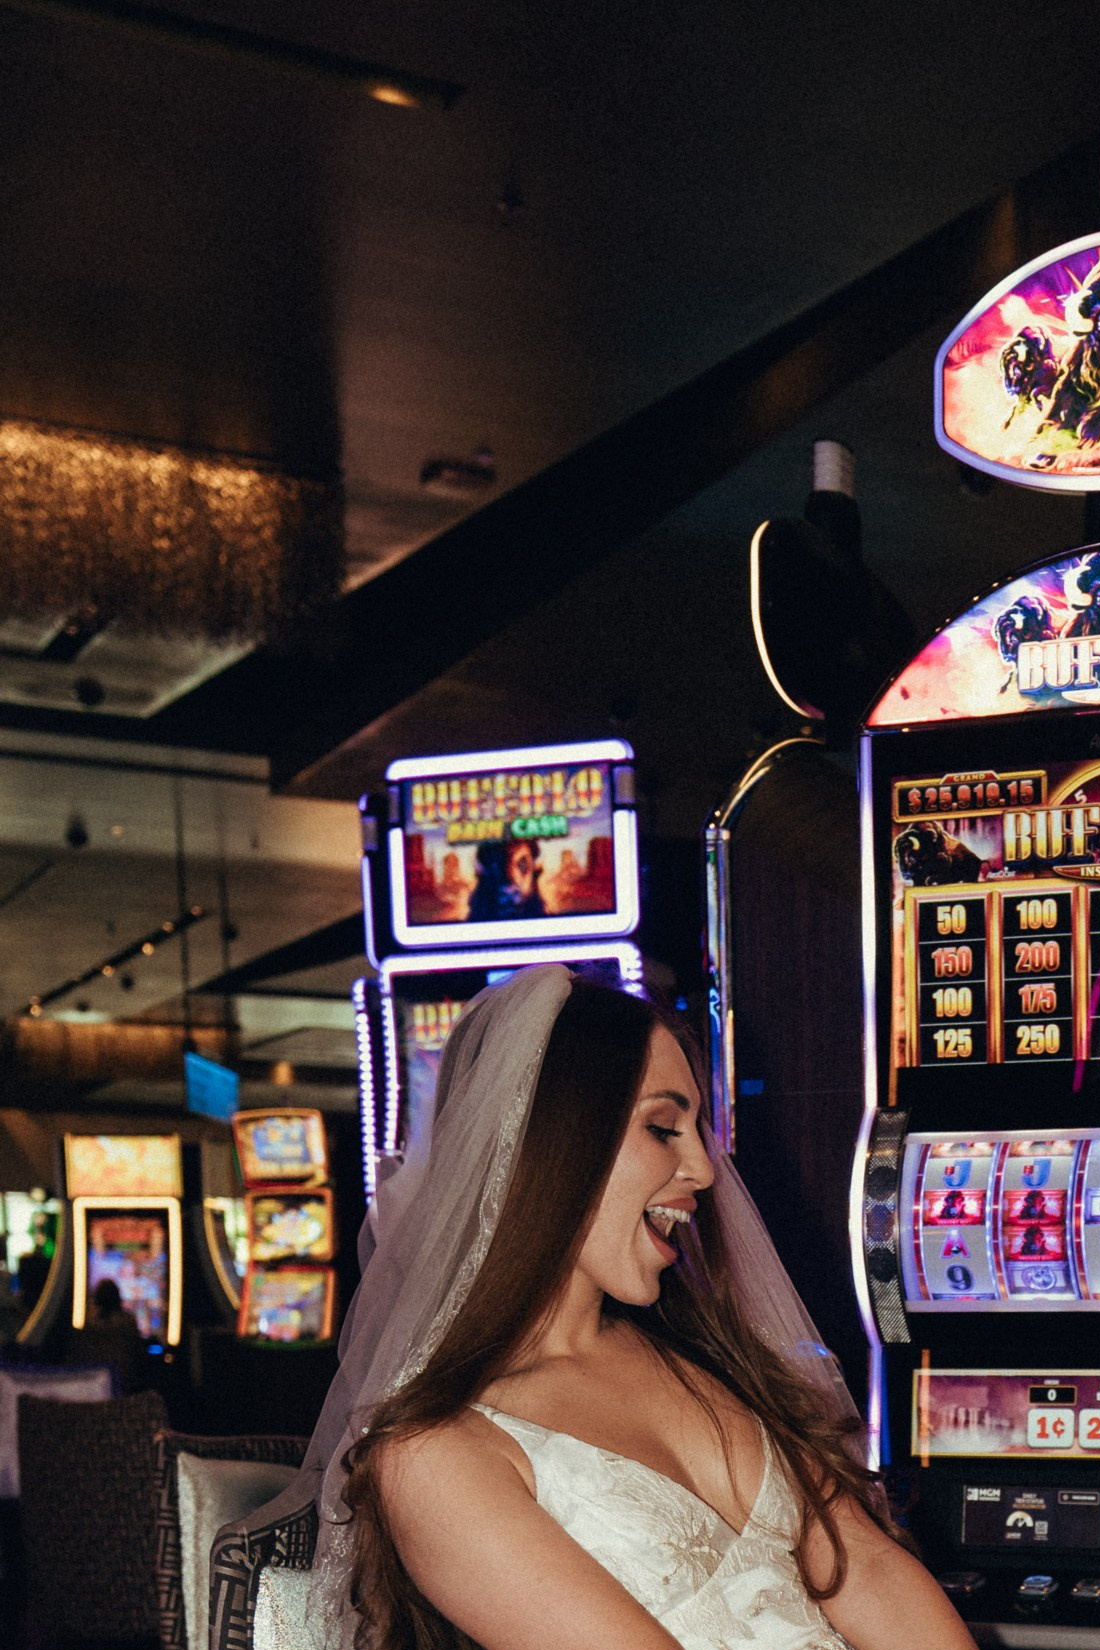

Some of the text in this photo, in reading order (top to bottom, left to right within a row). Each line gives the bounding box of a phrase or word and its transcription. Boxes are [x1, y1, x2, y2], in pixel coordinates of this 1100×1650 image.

[953, 773, 986, 782] GRAND
[937, 904, 967, 935] 50
[1016, 899, 1058, 930] 100
[932, 946, 972, 978] 150
[1015, 940, 1060, 973] 200
[932, 987, 973, 1018] 100
[1018, 983, 1057, 1014] 175
[933, 1028, 973, 1058] 125
[1016, 1024, 1060, 1055] 250
[943, 1159, 972, 1188] J
[1022, 1159, 1052, 1188] J
[940, 1227, 971, 1258] A
[946, 1264, 973, 1291] 9
[1047, 1388, 1057, 1400] 0
[1036, 1416, 1065, 1439] 1¢
[979, 1488, 1001, 1497] MGM
